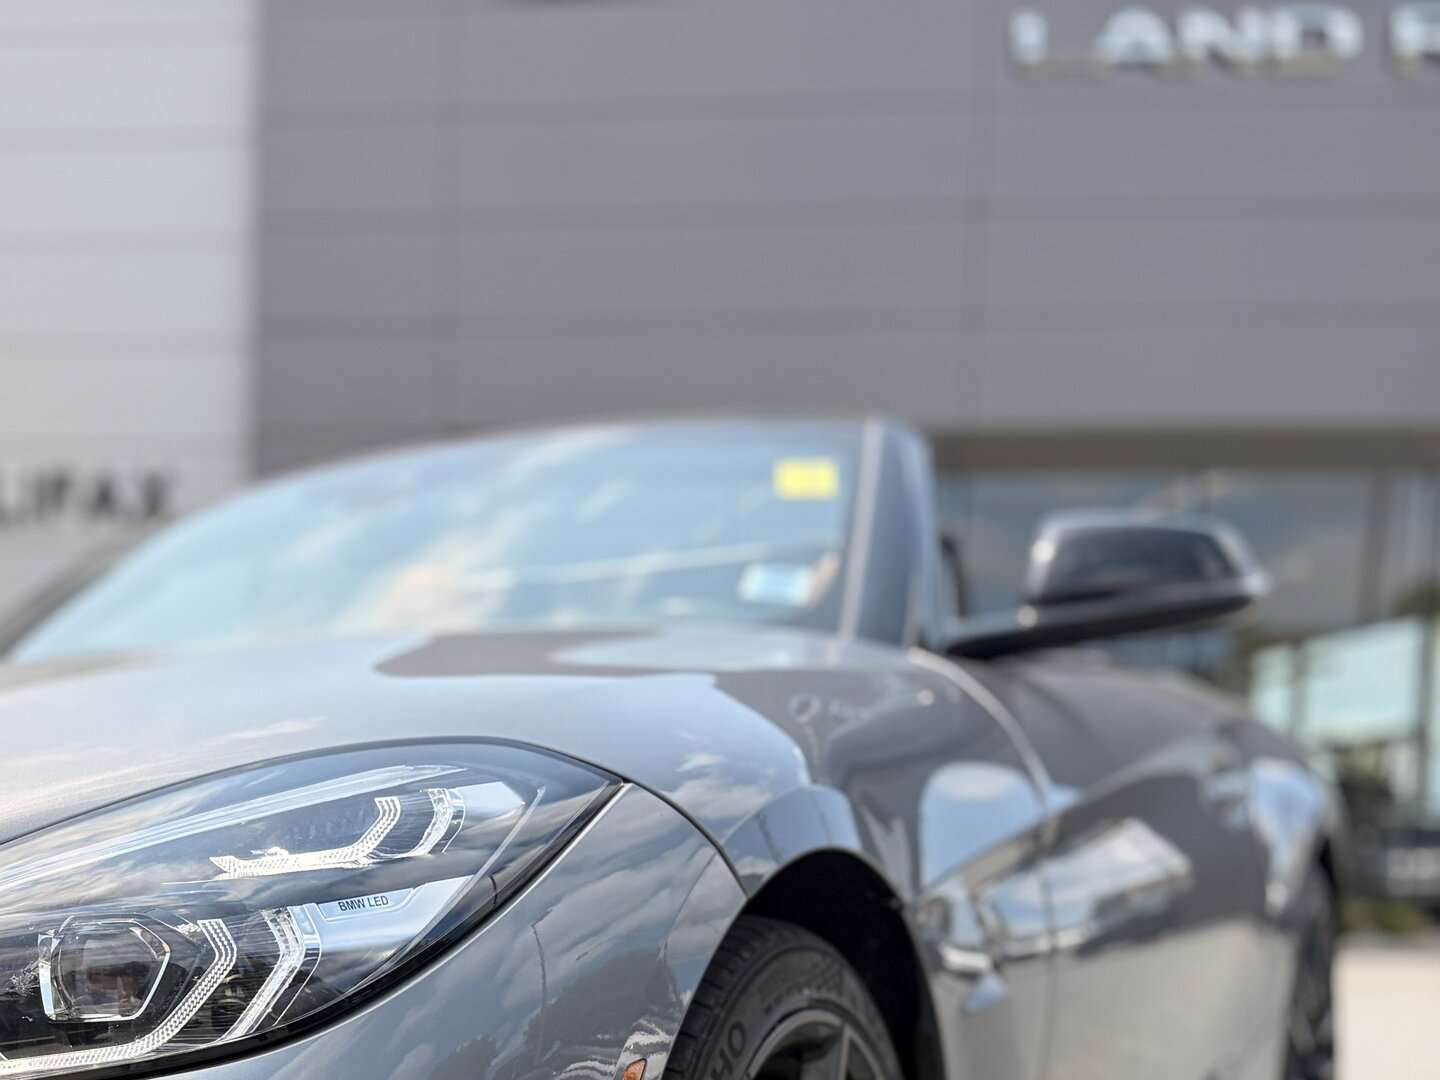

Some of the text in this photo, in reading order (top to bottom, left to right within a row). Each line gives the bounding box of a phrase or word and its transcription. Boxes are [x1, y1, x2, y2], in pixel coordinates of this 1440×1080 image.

[1008, 6, 1364, 74] LAND
[337, 895, 389, 912] BMW LED
